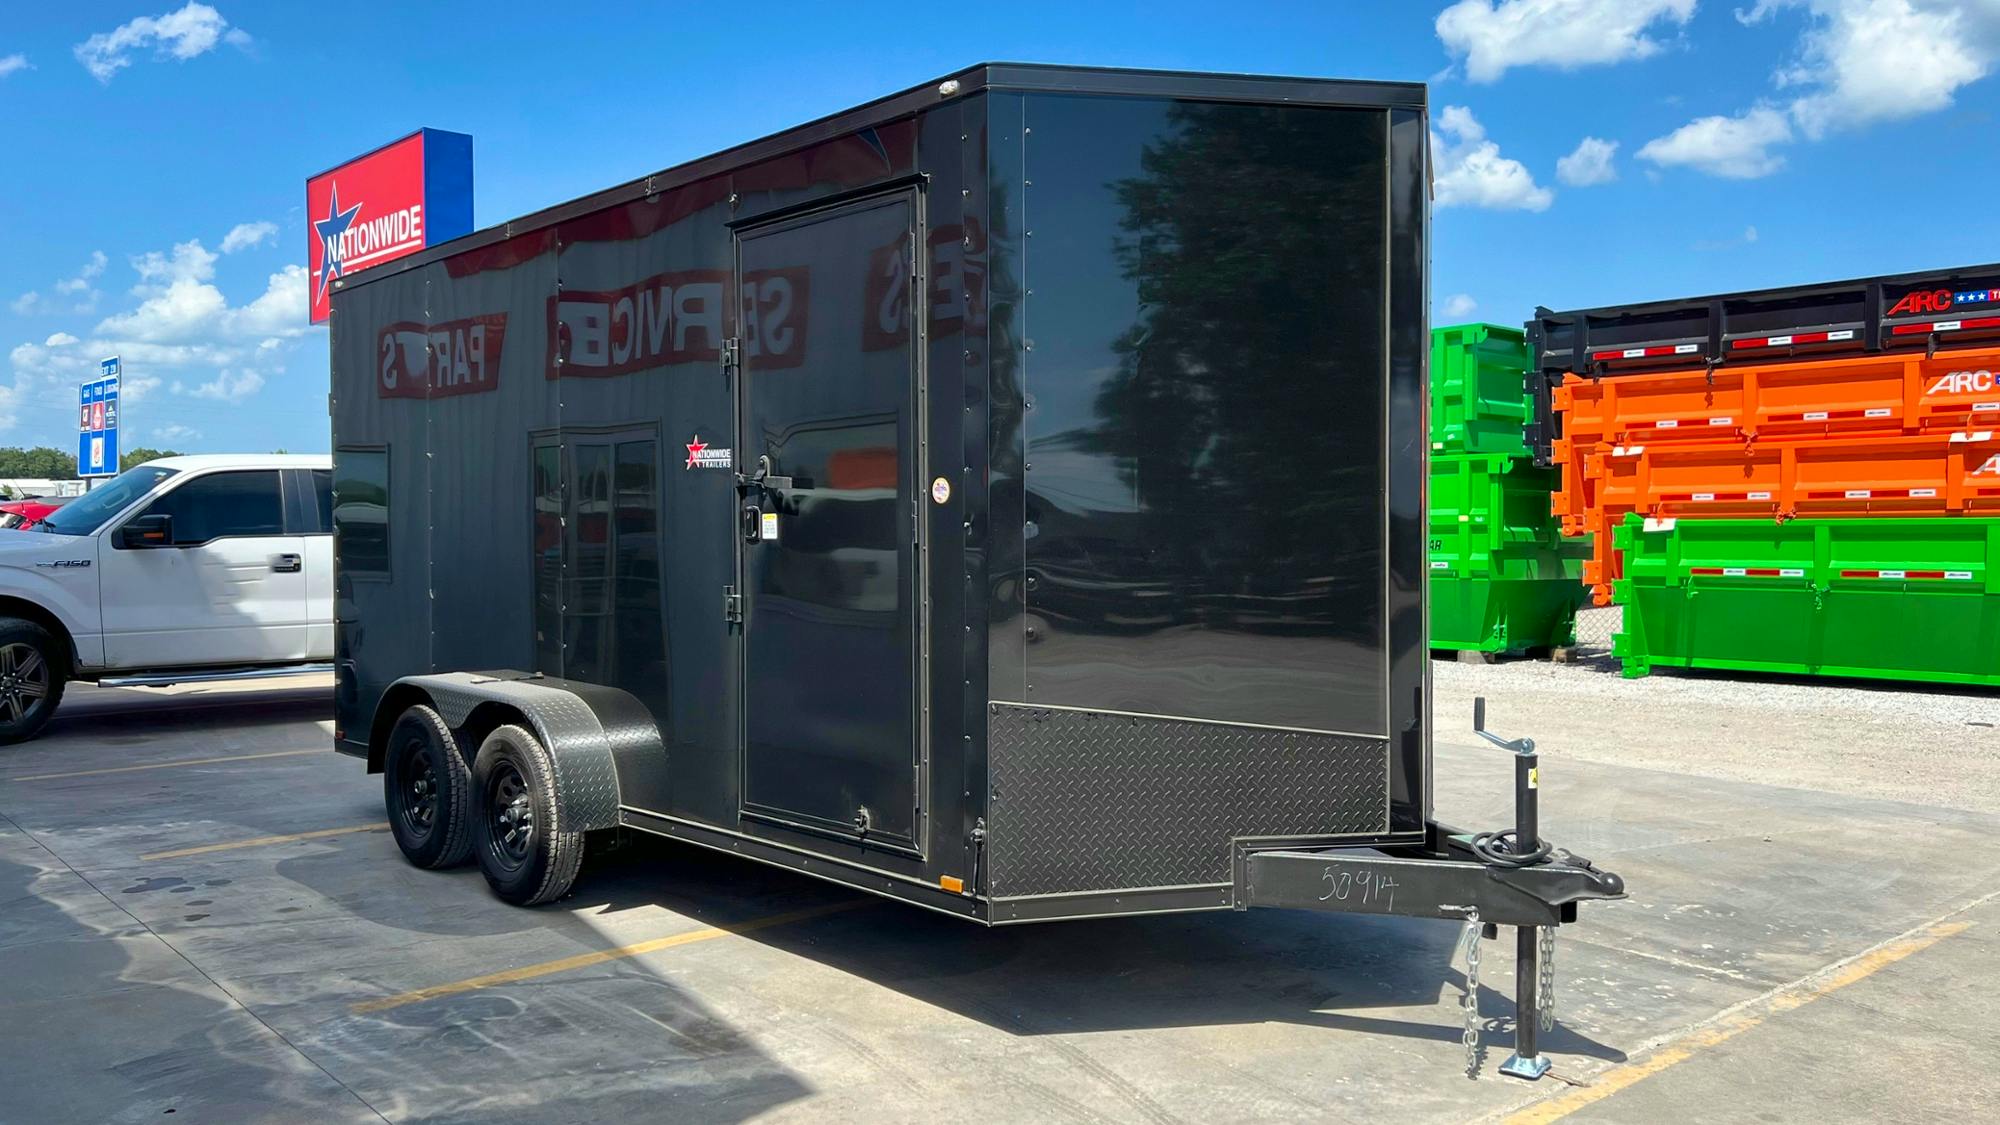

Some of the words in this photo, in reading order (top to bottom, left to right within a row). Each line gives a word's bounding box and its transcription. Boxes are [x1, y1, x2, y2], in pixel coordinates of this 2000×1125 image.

[327, 205, 421, 264] NATIONWIDE
[1887, 289, 1952, 315] ARC
[1926, 370, 1992, 395] ARC
[692, 448, 731, 459] NATIONWIDE
[1318, 863, 1400, 912] 50914
